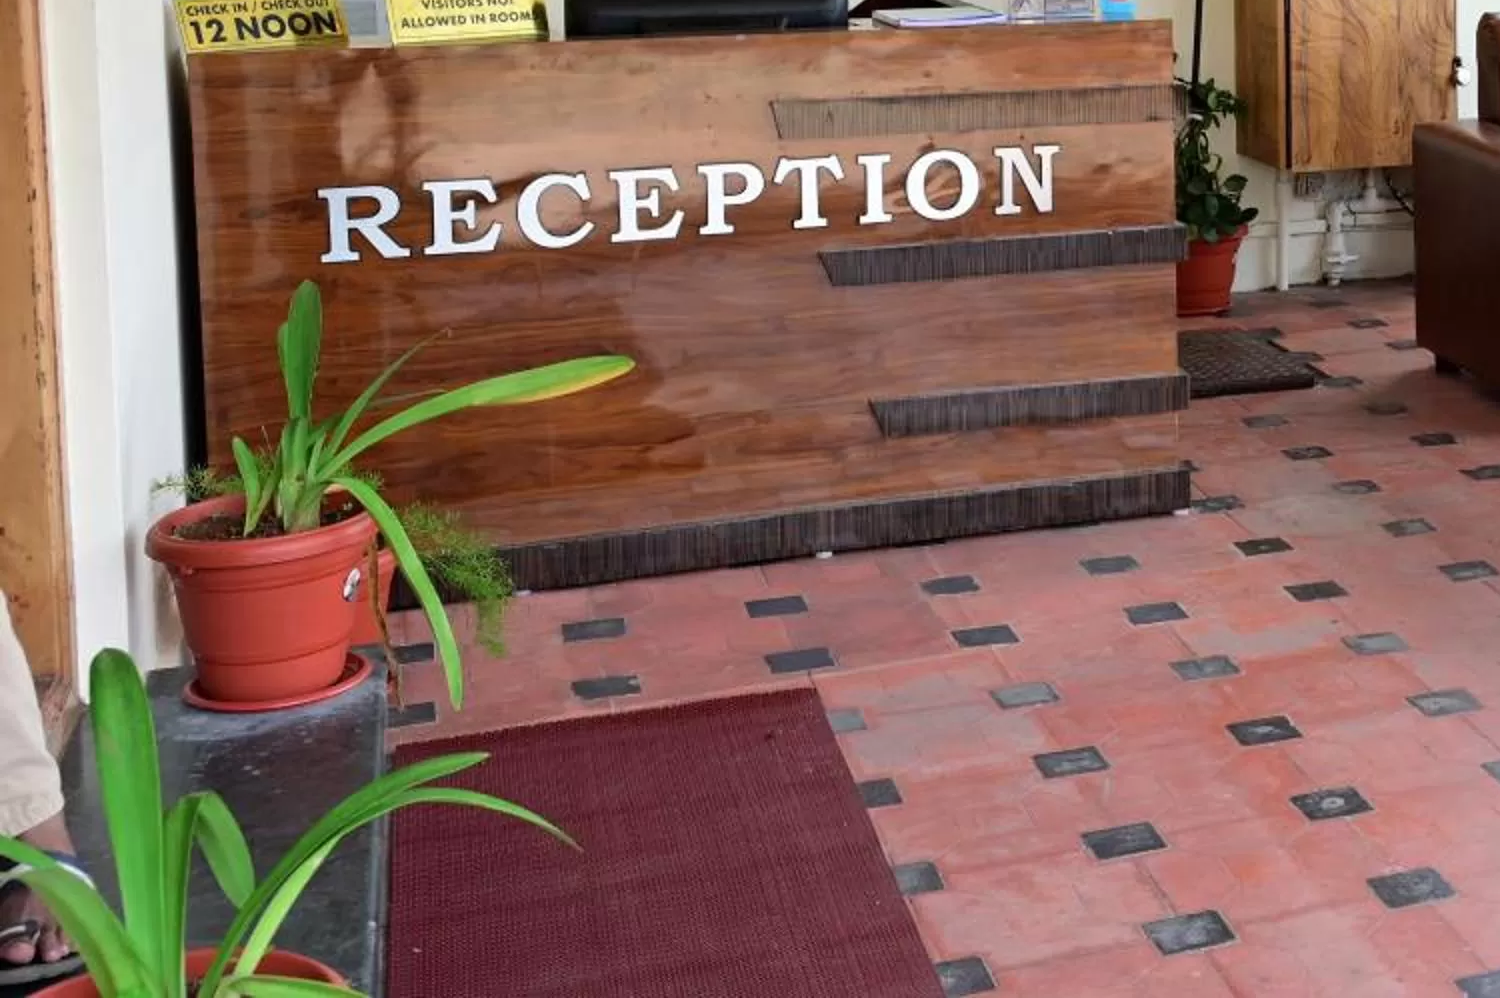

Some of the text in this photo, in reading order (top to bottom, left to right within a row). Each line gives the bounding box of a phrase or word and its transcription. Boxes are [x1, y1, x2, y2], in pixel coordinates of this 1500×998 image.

[186, 2, 228, 16] CHECK
[233, 2, 248, 13] IN
[401, 10, 538, 29] ALLOWED IN ROOM
[189, 9, 338, 45] 12 NOON
[317, 144, 1063, 263] RECEPTION
